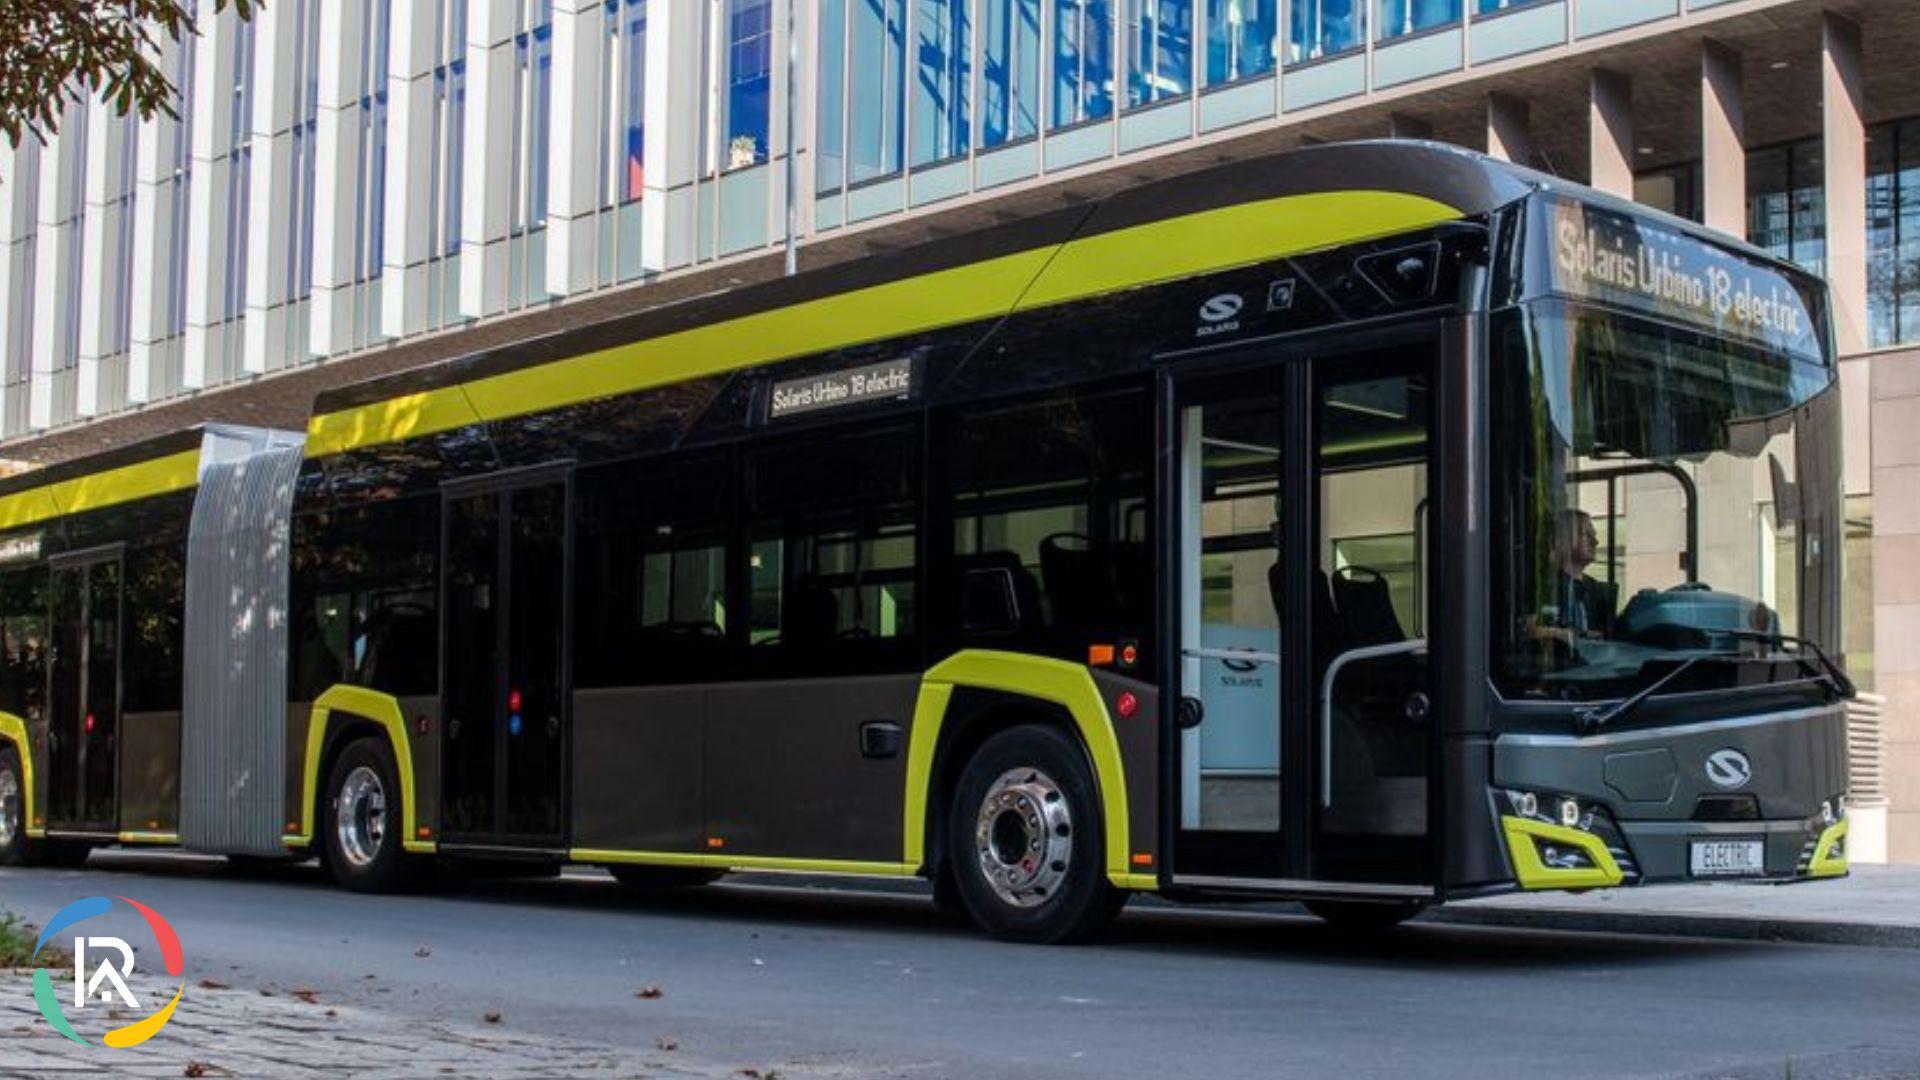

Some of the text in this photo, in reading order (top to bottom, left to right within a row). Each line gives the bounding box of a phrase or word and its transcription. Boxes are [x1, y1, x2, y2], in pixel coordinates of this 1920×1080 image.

[1558, 218, 1800, 335] Solaris Urbino 18 electric
[1196, 320, 1240, 337] SOLARIS
[773, 368, 910, 411] Solaris Urbino 18 electric
[1703, 843, 1752, 868] ELECTRIC
